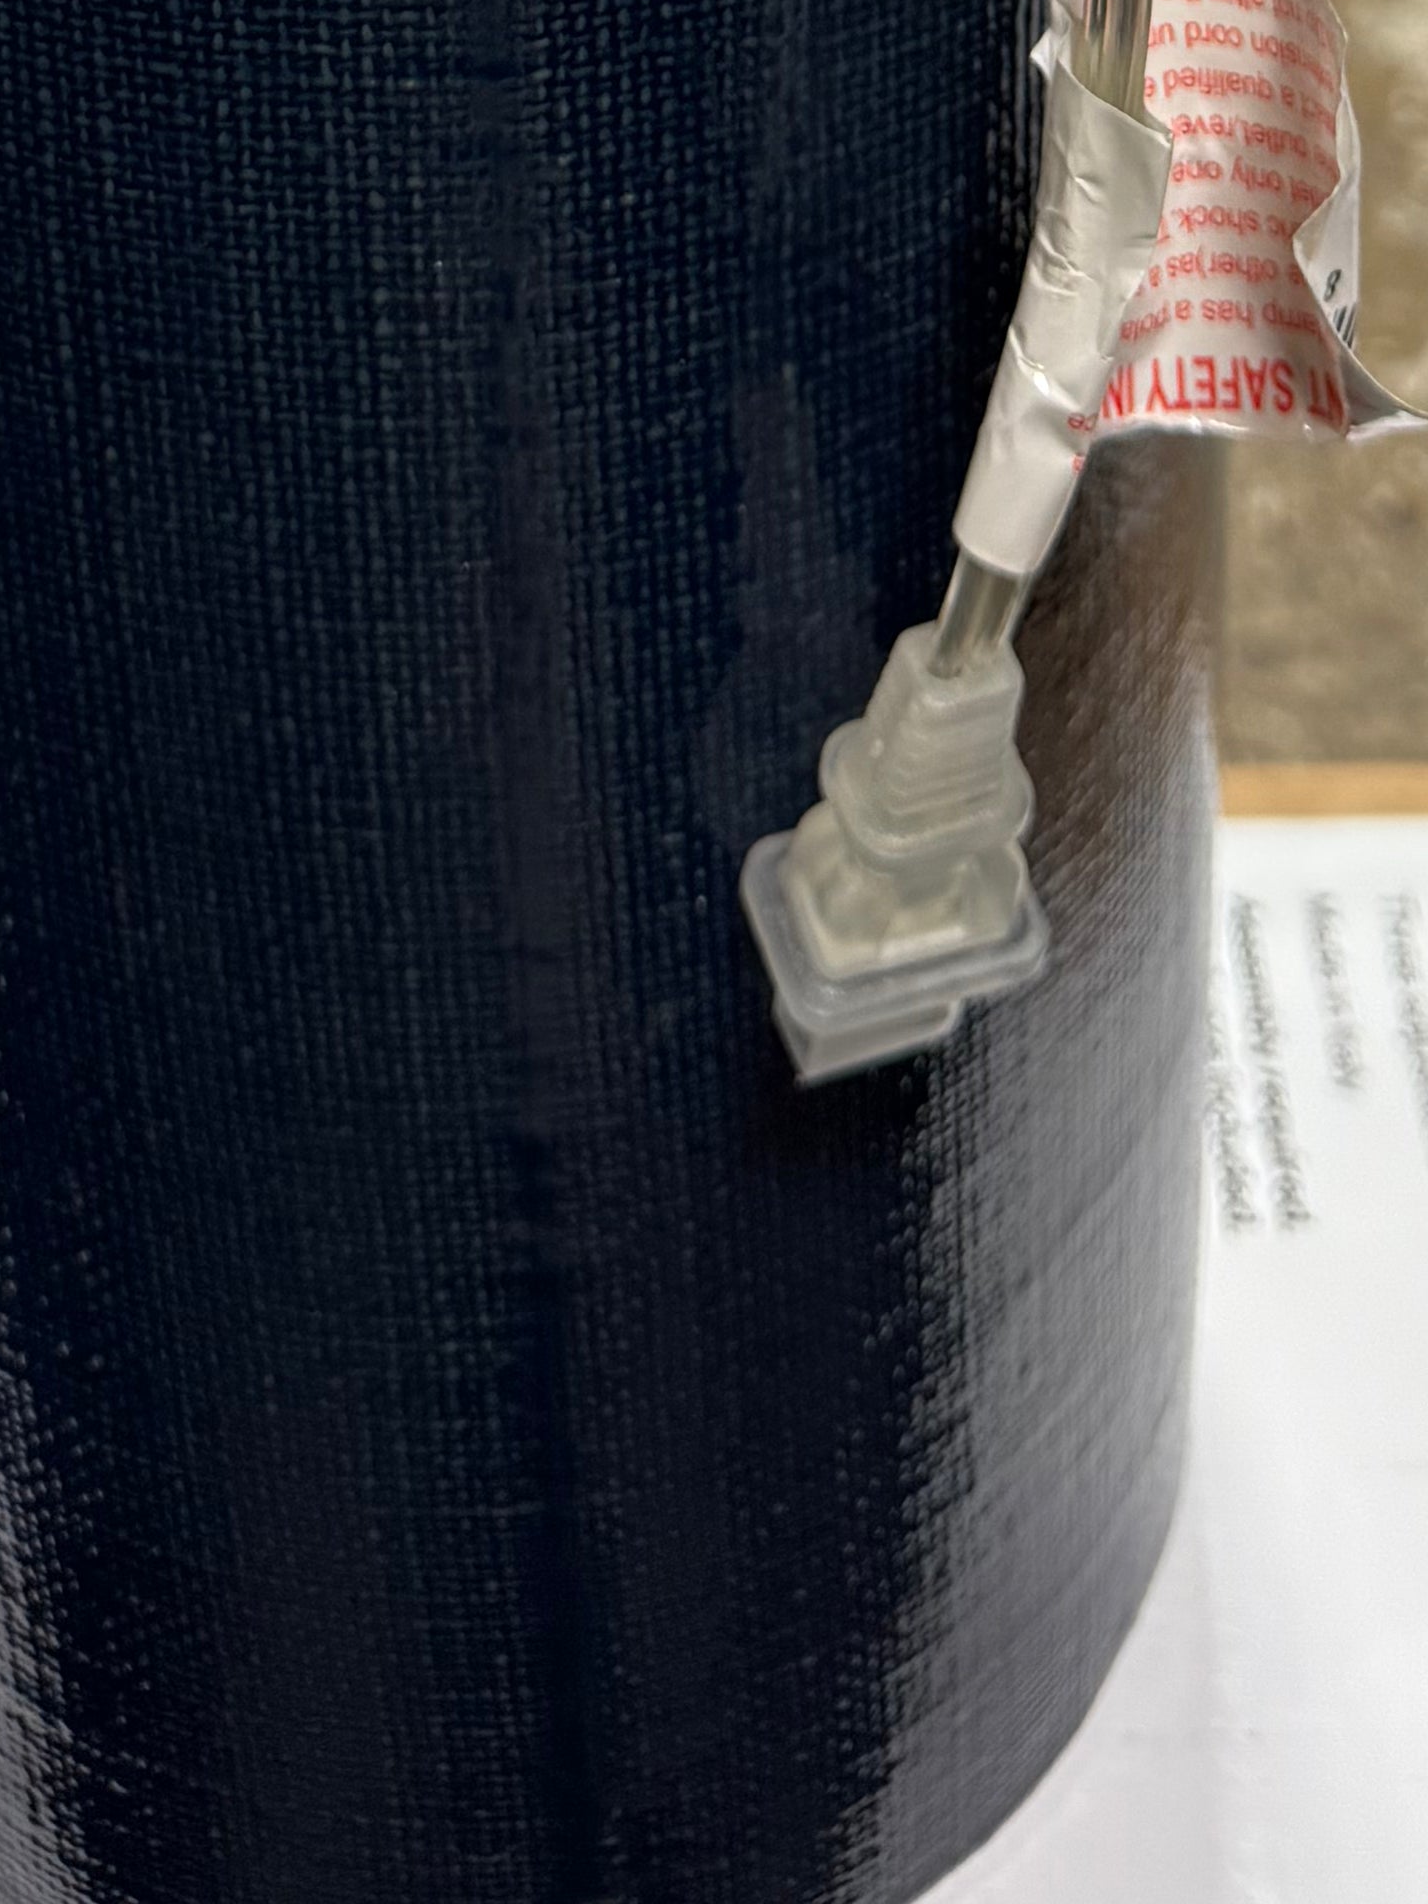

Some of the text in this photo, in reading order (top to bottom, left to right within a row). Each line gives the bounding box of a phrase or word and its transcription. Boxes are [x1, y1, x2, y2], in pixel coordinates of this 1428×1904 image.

[1184, 20, 1243, 49] cord
[1162, 66, 1274, 101] qualified
[1172, 159, 1223, 184] one
[1231, 155, 1283, 192] only
[1200, 297, 1255, 330] has
[1145, 354, 1295, 414] SAFETY
